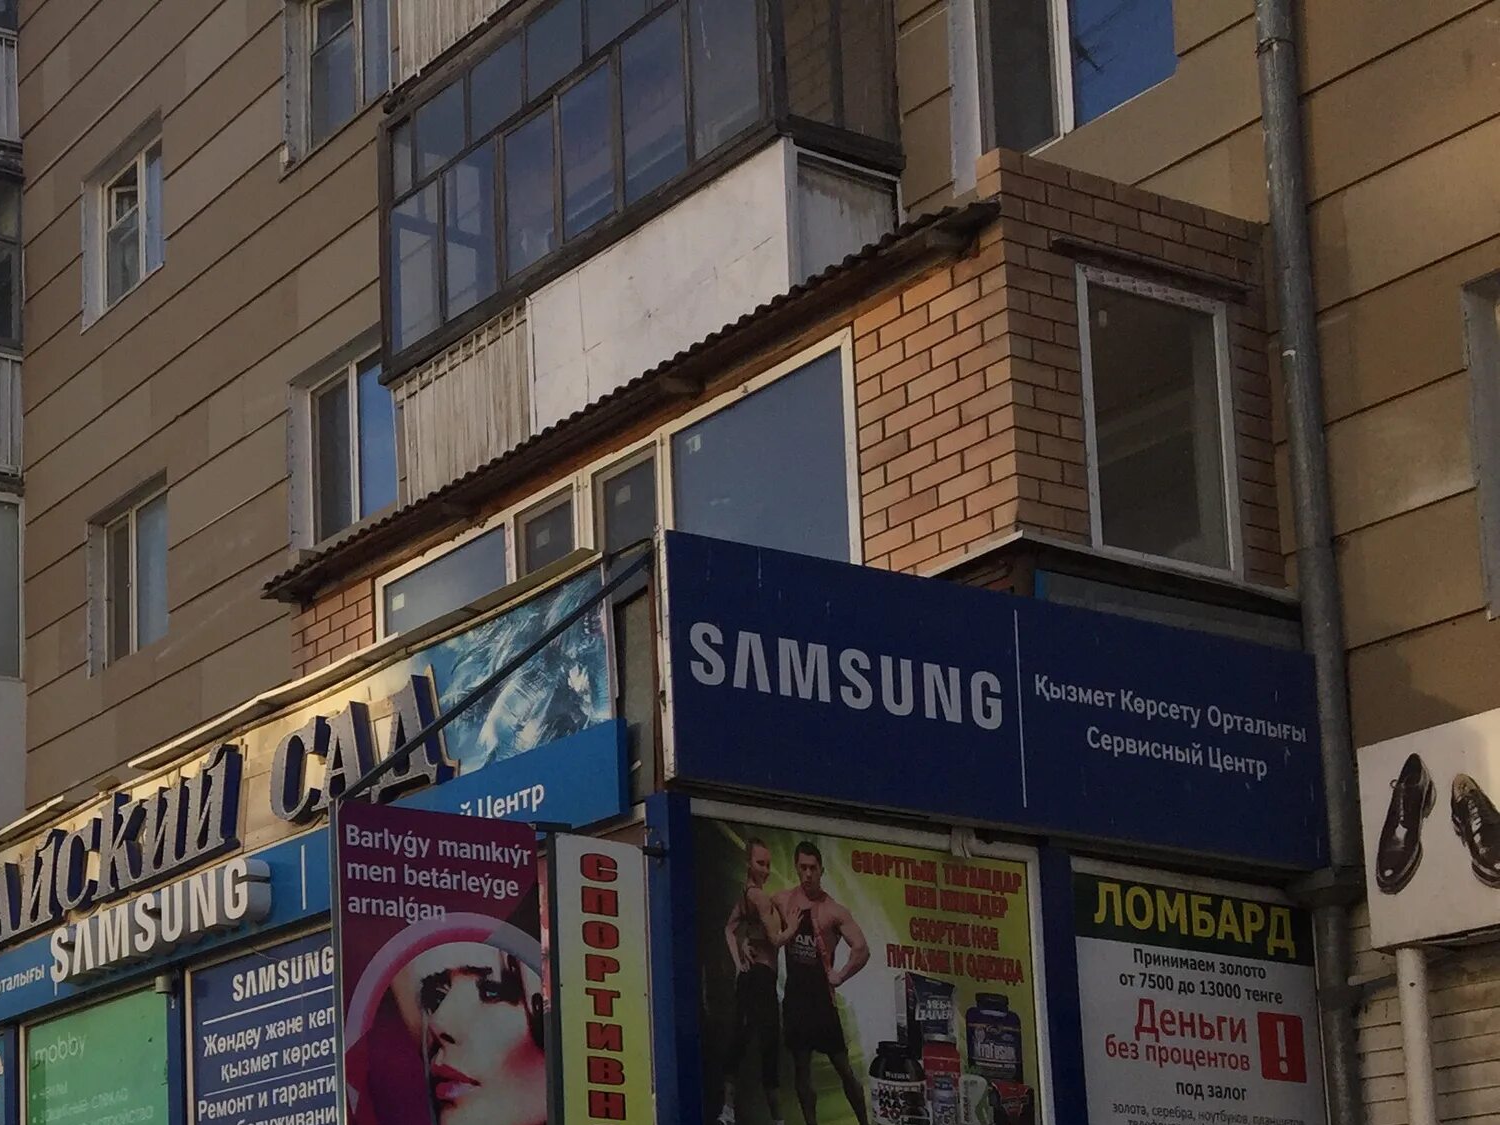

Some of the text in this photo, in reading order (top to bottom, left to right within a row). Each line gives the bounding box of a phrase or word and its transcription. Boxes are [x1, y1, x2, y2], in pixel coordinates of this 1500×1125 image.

[689, 621, 1003, 730] SAMSUNG
[1035, 673, 1307, 743] Қызмет Көрсету Орталығы
[1087, 726, 1268, 780] Сервисный Центр
[347, 862, 396, 884] men
[50, 858, 262, 984] SAMSUNG
[1094, 881, 1296, 958] ЛОМБАРД
[232, 946, 334, 1001] SAMSUNG
[1133, 947, 1266, 980] Принимаем золото
[1119, 972, 1283, 1005] от 7500 до 13000 тенге
[204, 1026, 261, 1057] Жөндеу
[265, 1015, 303, 1042] және
[1134, 998, 1248, 1044] Деньги
[221, 1051, 278, 1083] қызмет
[1105, 1034, 1250, 1072] без процентов
[198, 1075, 336, 1122] Ремонт и гаранти
[1176, 1081, 1247, 1101] под залог
